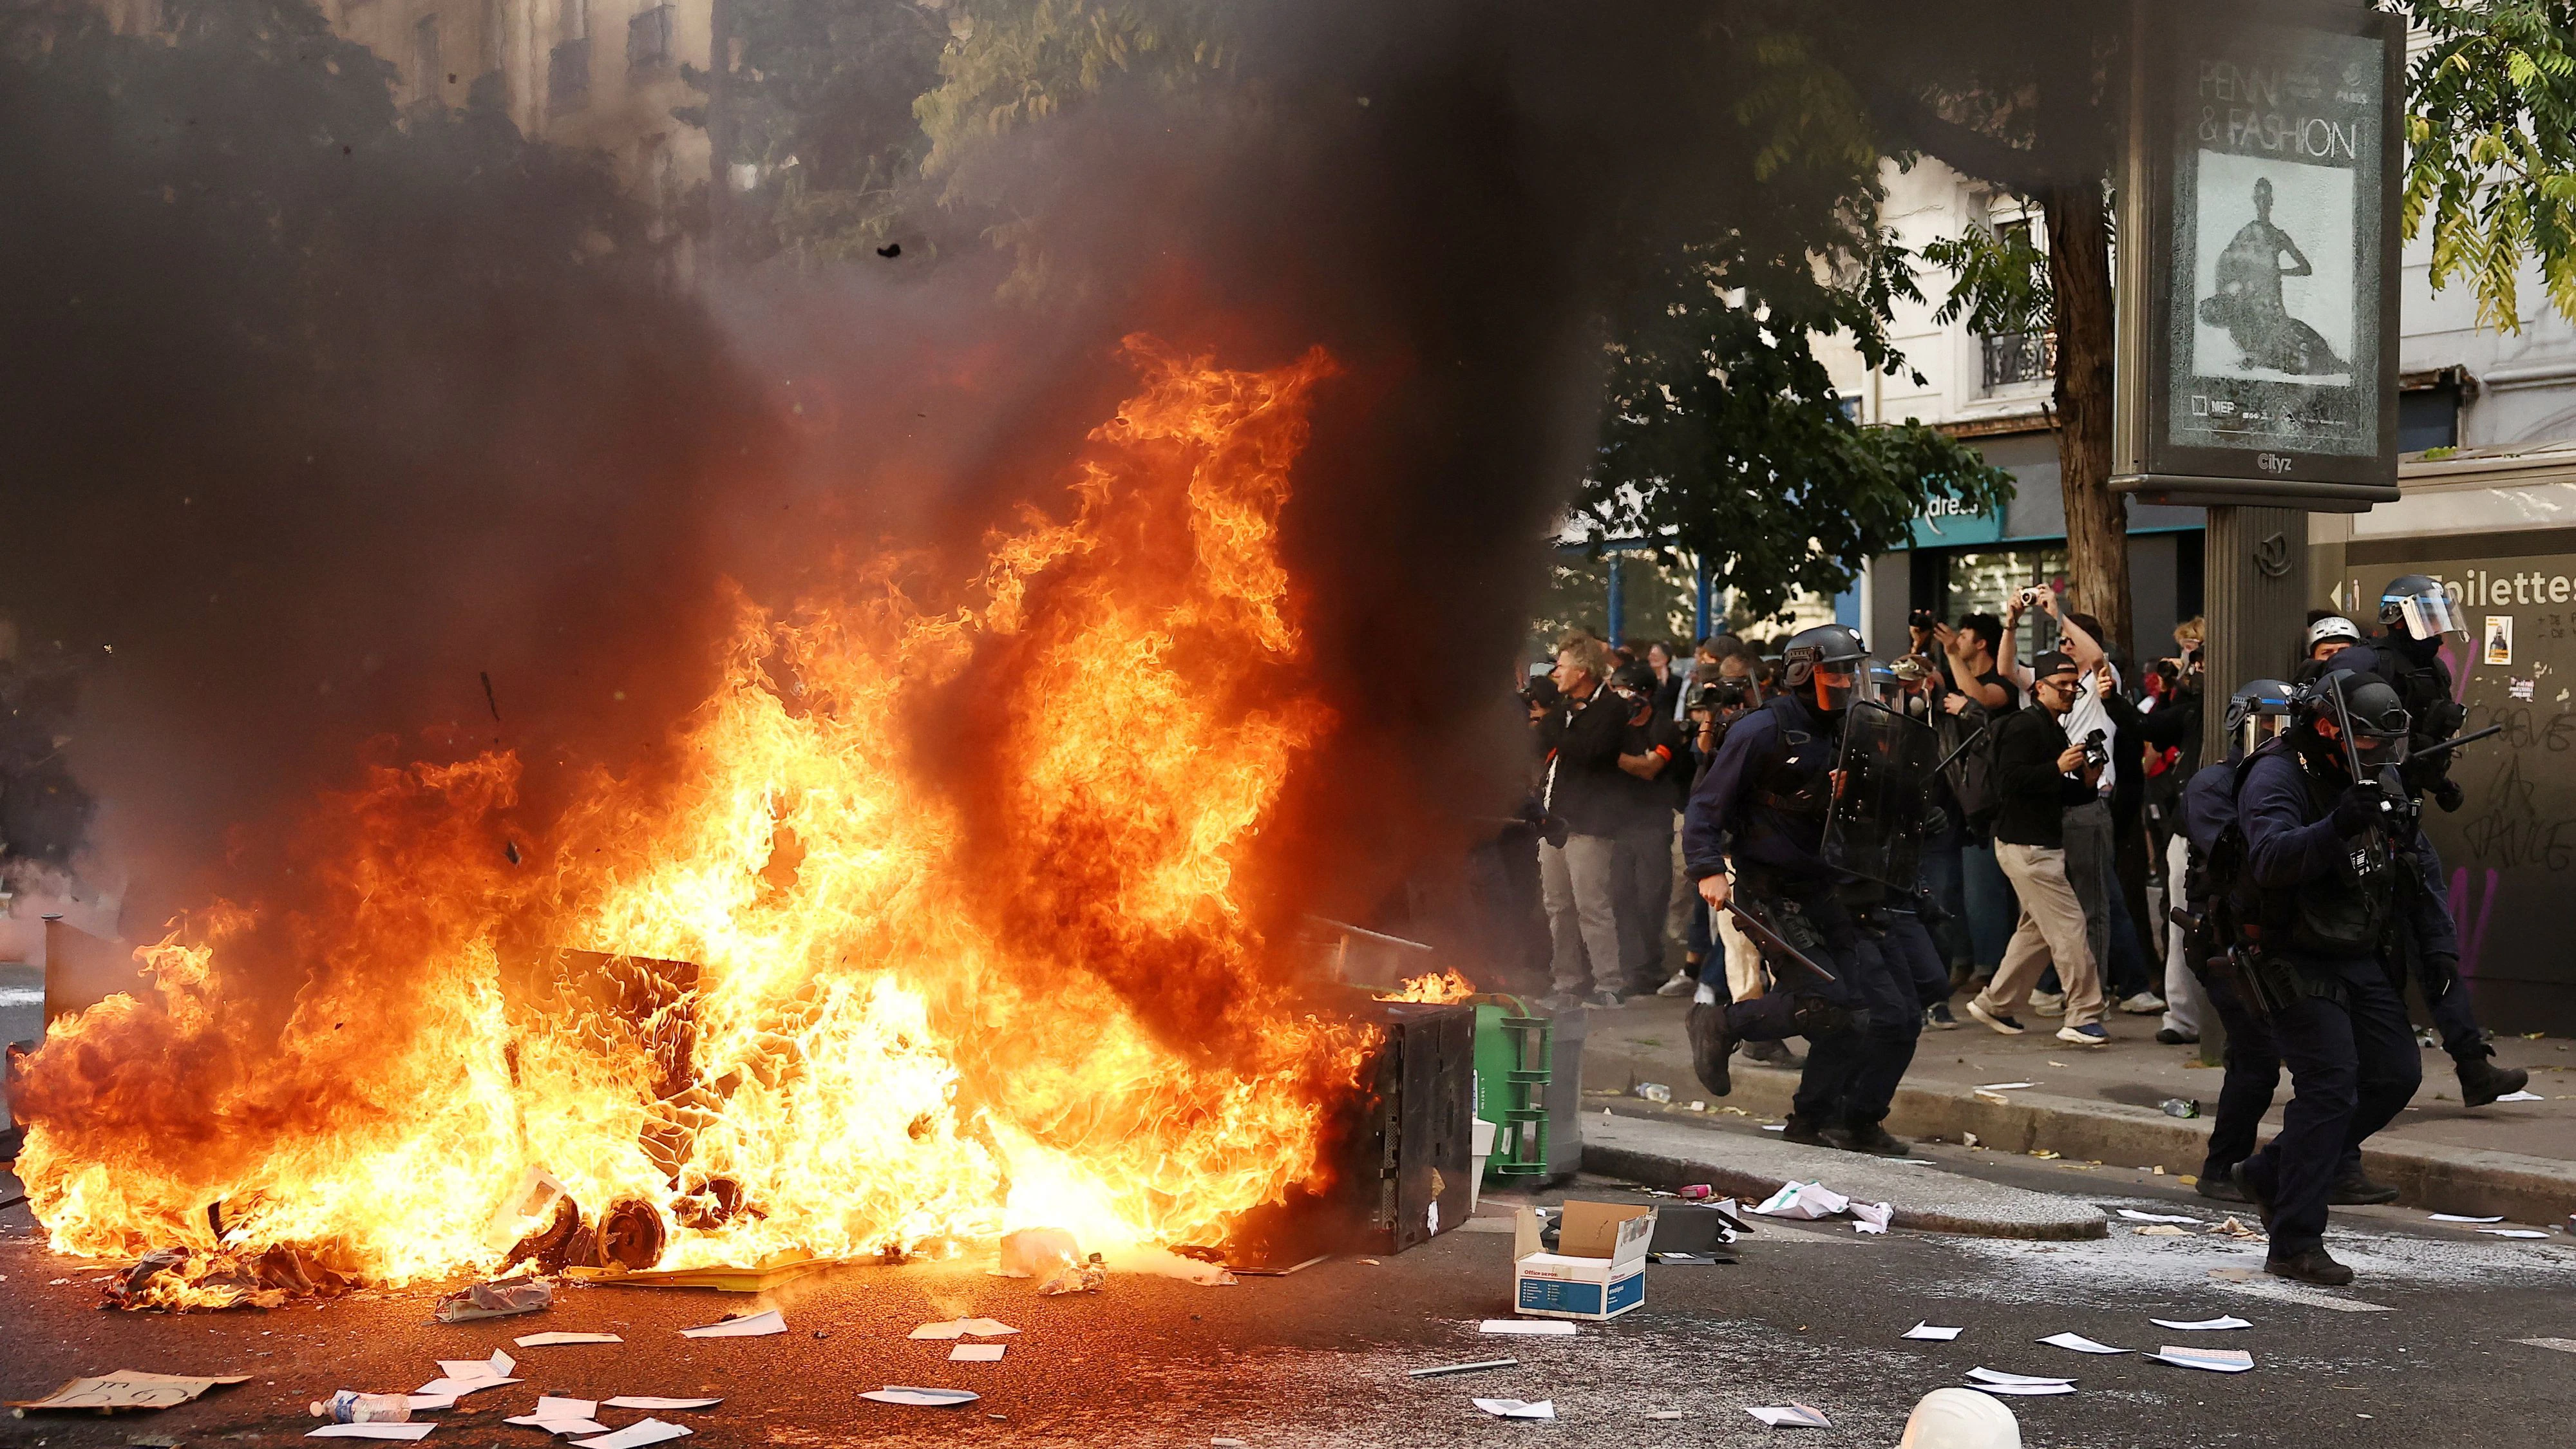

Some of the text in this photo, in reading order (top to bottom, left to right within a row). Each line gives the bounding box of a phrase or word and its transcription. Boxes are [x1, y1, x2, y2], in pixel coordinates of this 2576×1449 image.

[2199, 105, 2356, 160] & FASHION
[2211, 400, 2235, 414] MEP
[2257, 453, 2292, 473] Cityz
[2427, 569, 2576, 606] oilette
